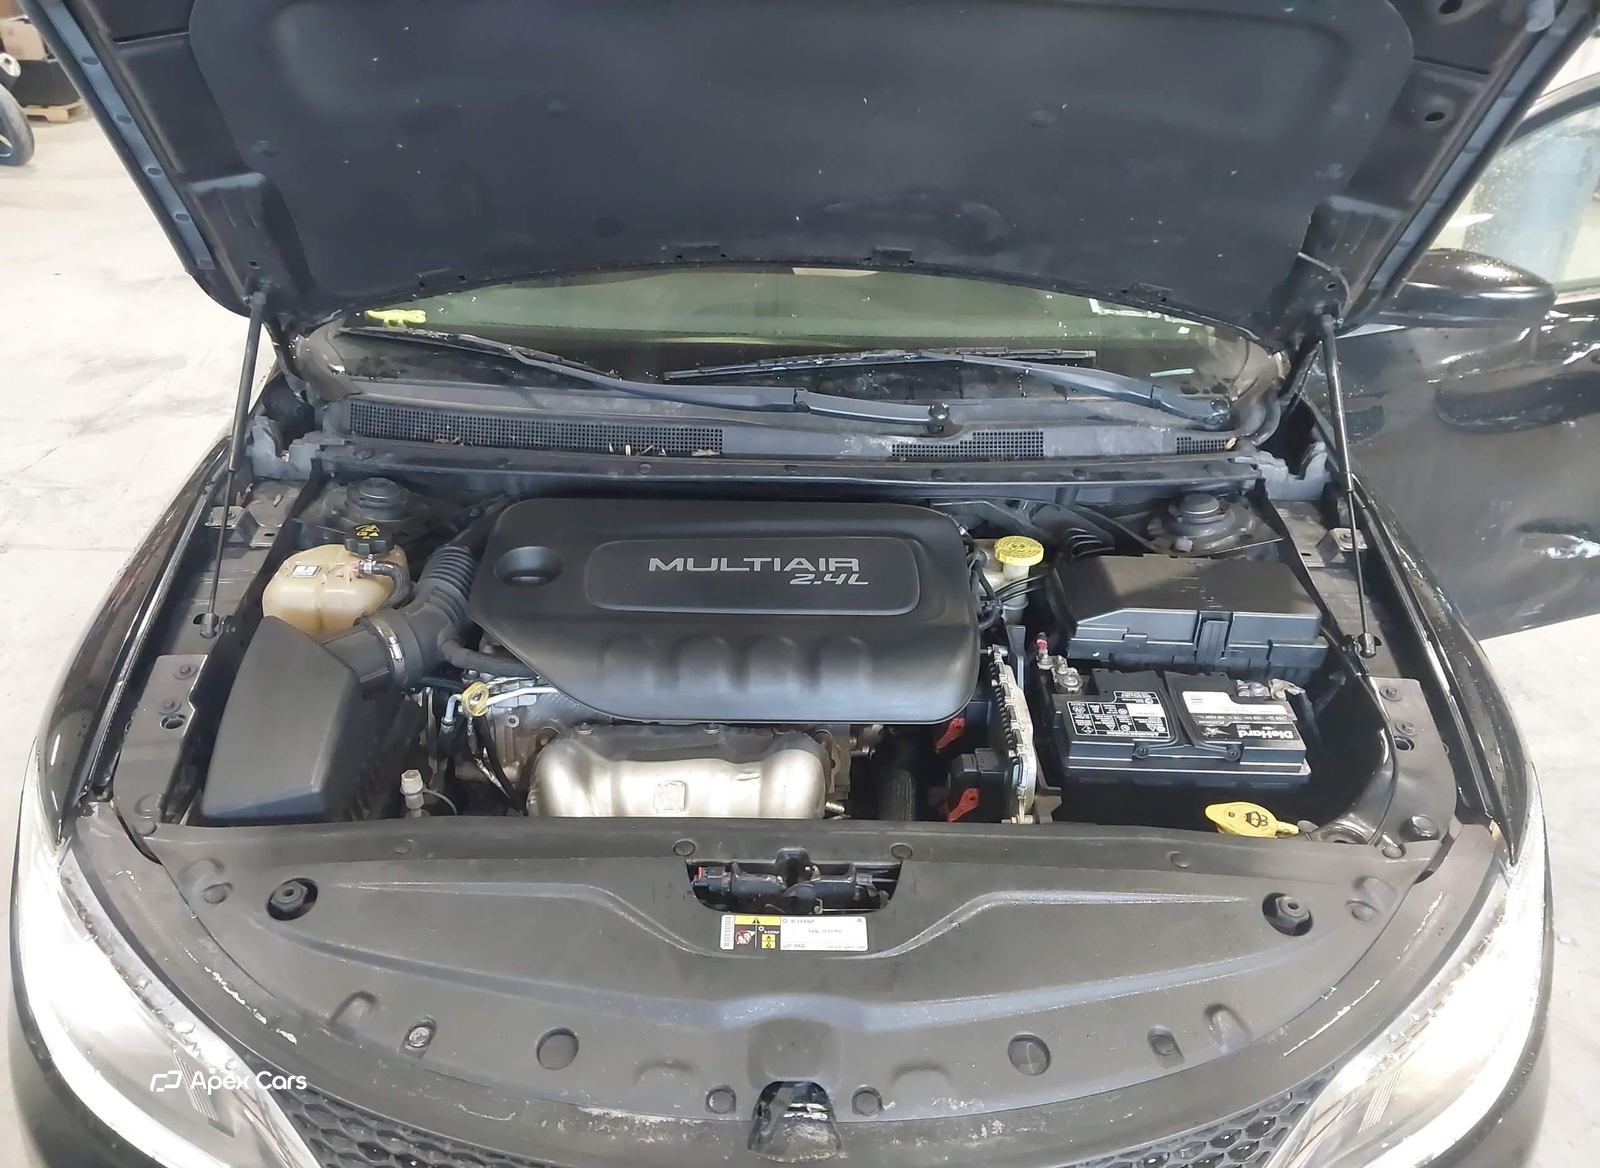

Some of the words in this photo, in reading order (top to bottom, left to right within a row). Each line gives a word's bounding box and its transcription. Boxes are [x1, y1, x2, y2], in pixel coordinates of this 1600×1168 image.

[649, 558, 859, 572] MULTIAIR
[790, 573, 869, 585] 2.4L
[1237, 729, 1294, 739] DieHard
